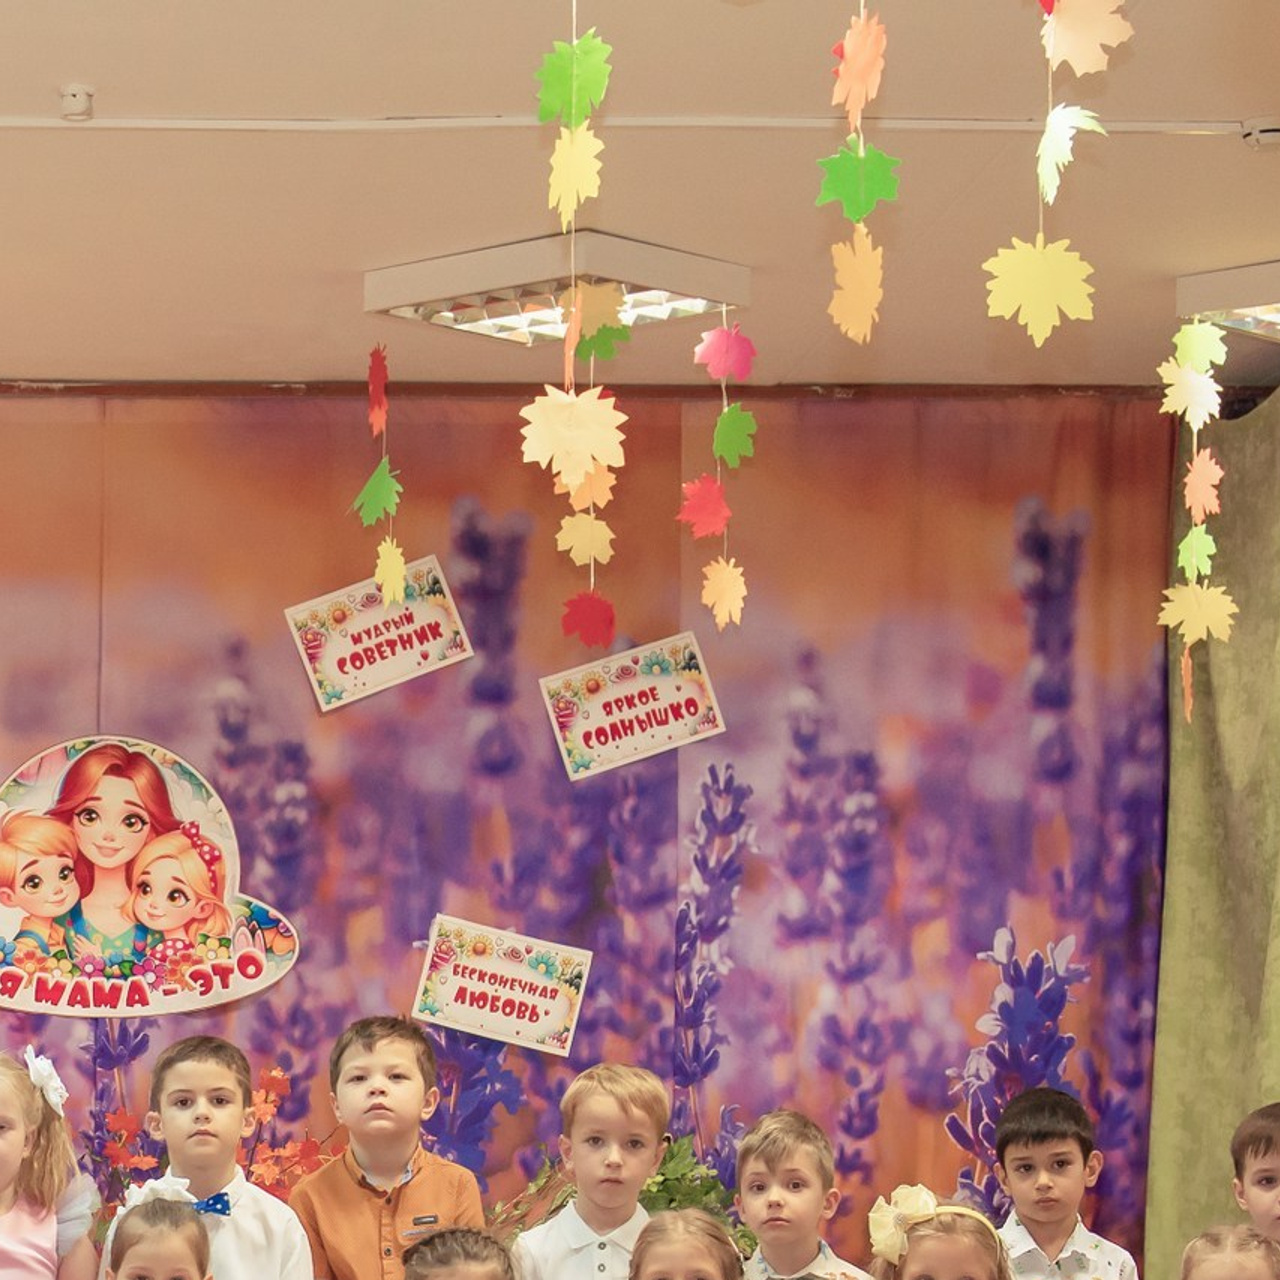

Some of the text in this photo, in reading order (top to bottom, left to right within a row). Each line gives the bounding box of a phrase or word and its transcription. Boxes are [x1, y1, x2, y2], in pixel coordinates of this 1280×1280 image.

[350, 607, 415, 646] МУДРЫЙ
[337, 620, 444, 675] СОВЕТНИК
[602, 686, 659, 716] ЯРКОЕ
[582, 697, 699, 749] СОЛНЫШКО
[34, 975, 152, 1009] МАМА
[189, 951, 264, 996] ЭТО
[452, 963, 559, 1000] БЕСКОНЕЧНАЯ
[454, 985, 540, 1023] ЛЮБОВЬ
